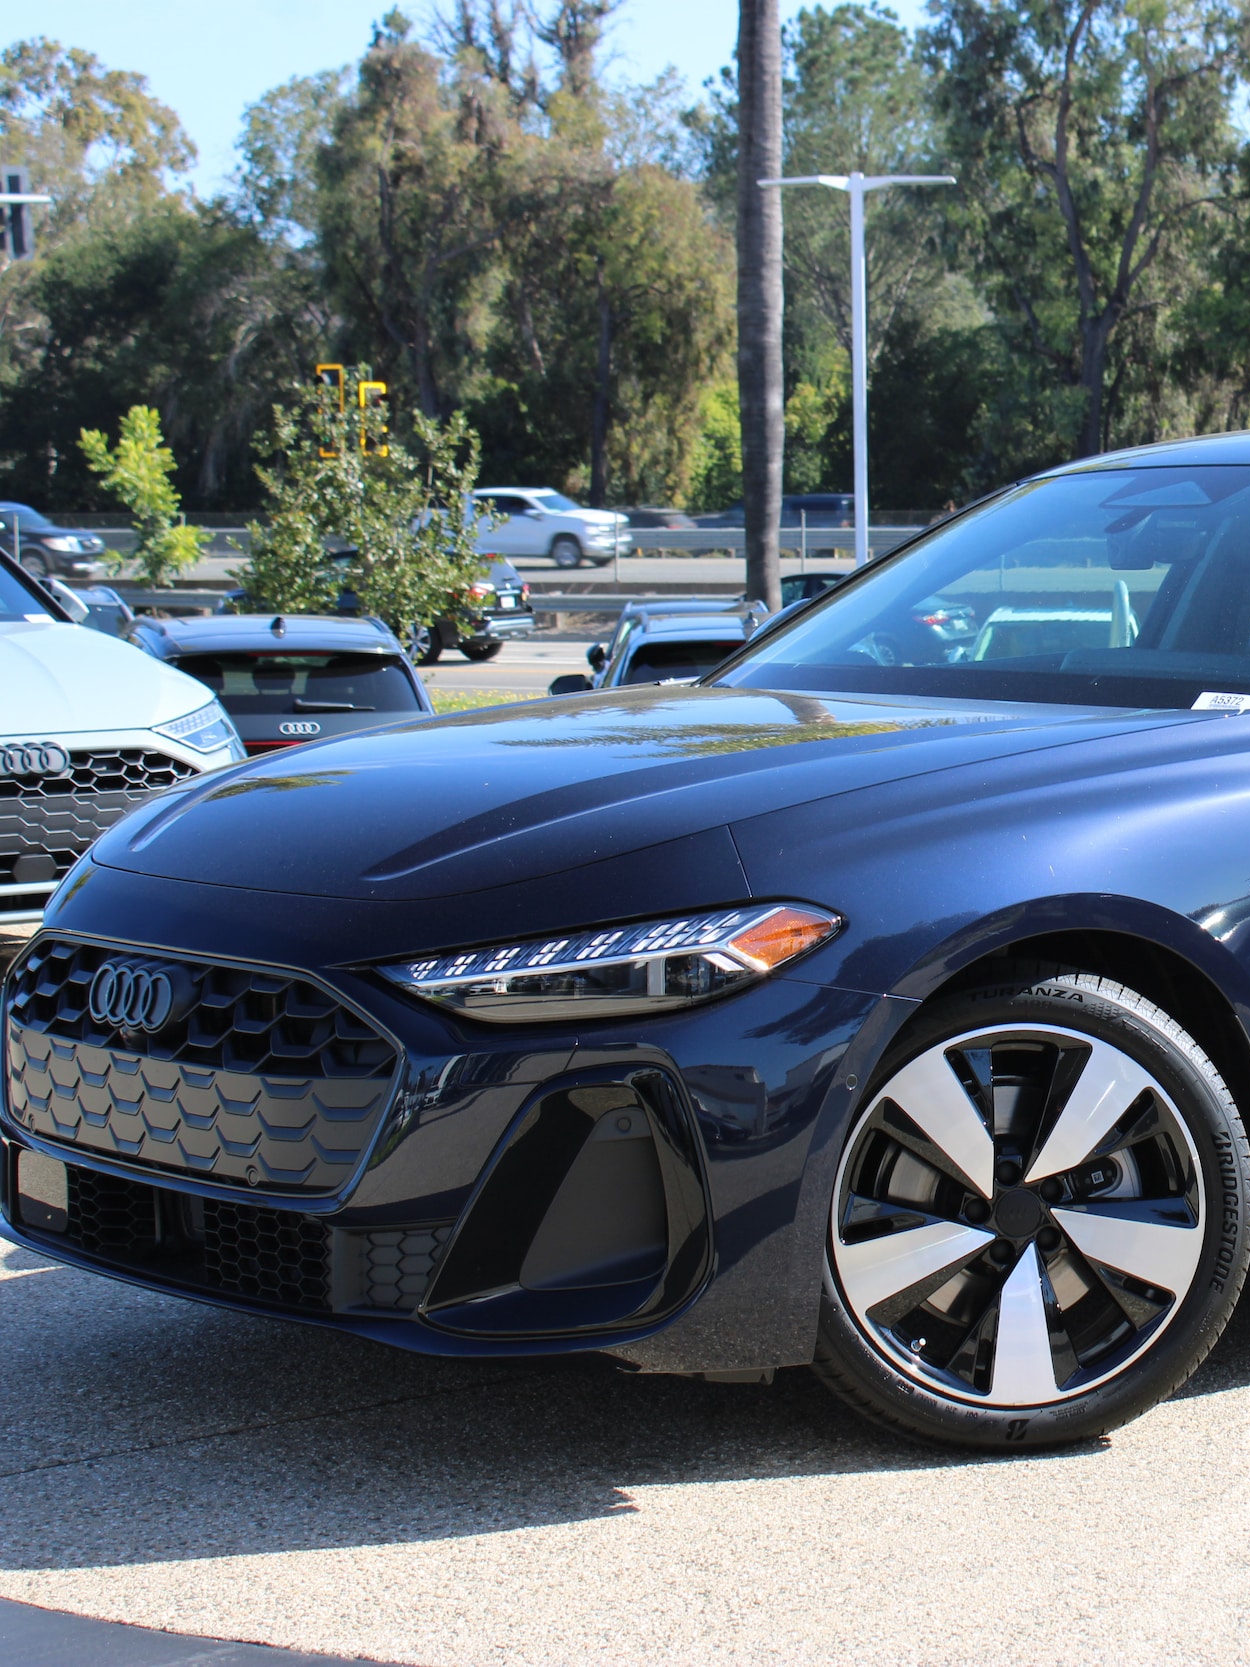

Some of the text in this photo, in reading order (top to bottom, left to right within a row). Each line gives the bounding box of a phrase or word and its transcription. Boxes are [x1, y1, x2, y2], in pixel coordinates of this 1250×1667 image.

[1209, 695, 1245, 705] A5372
[967, 986, 1084, 1003] TURANZA
[1209, 1130, 1240, 1295] BRIDGESTONE
